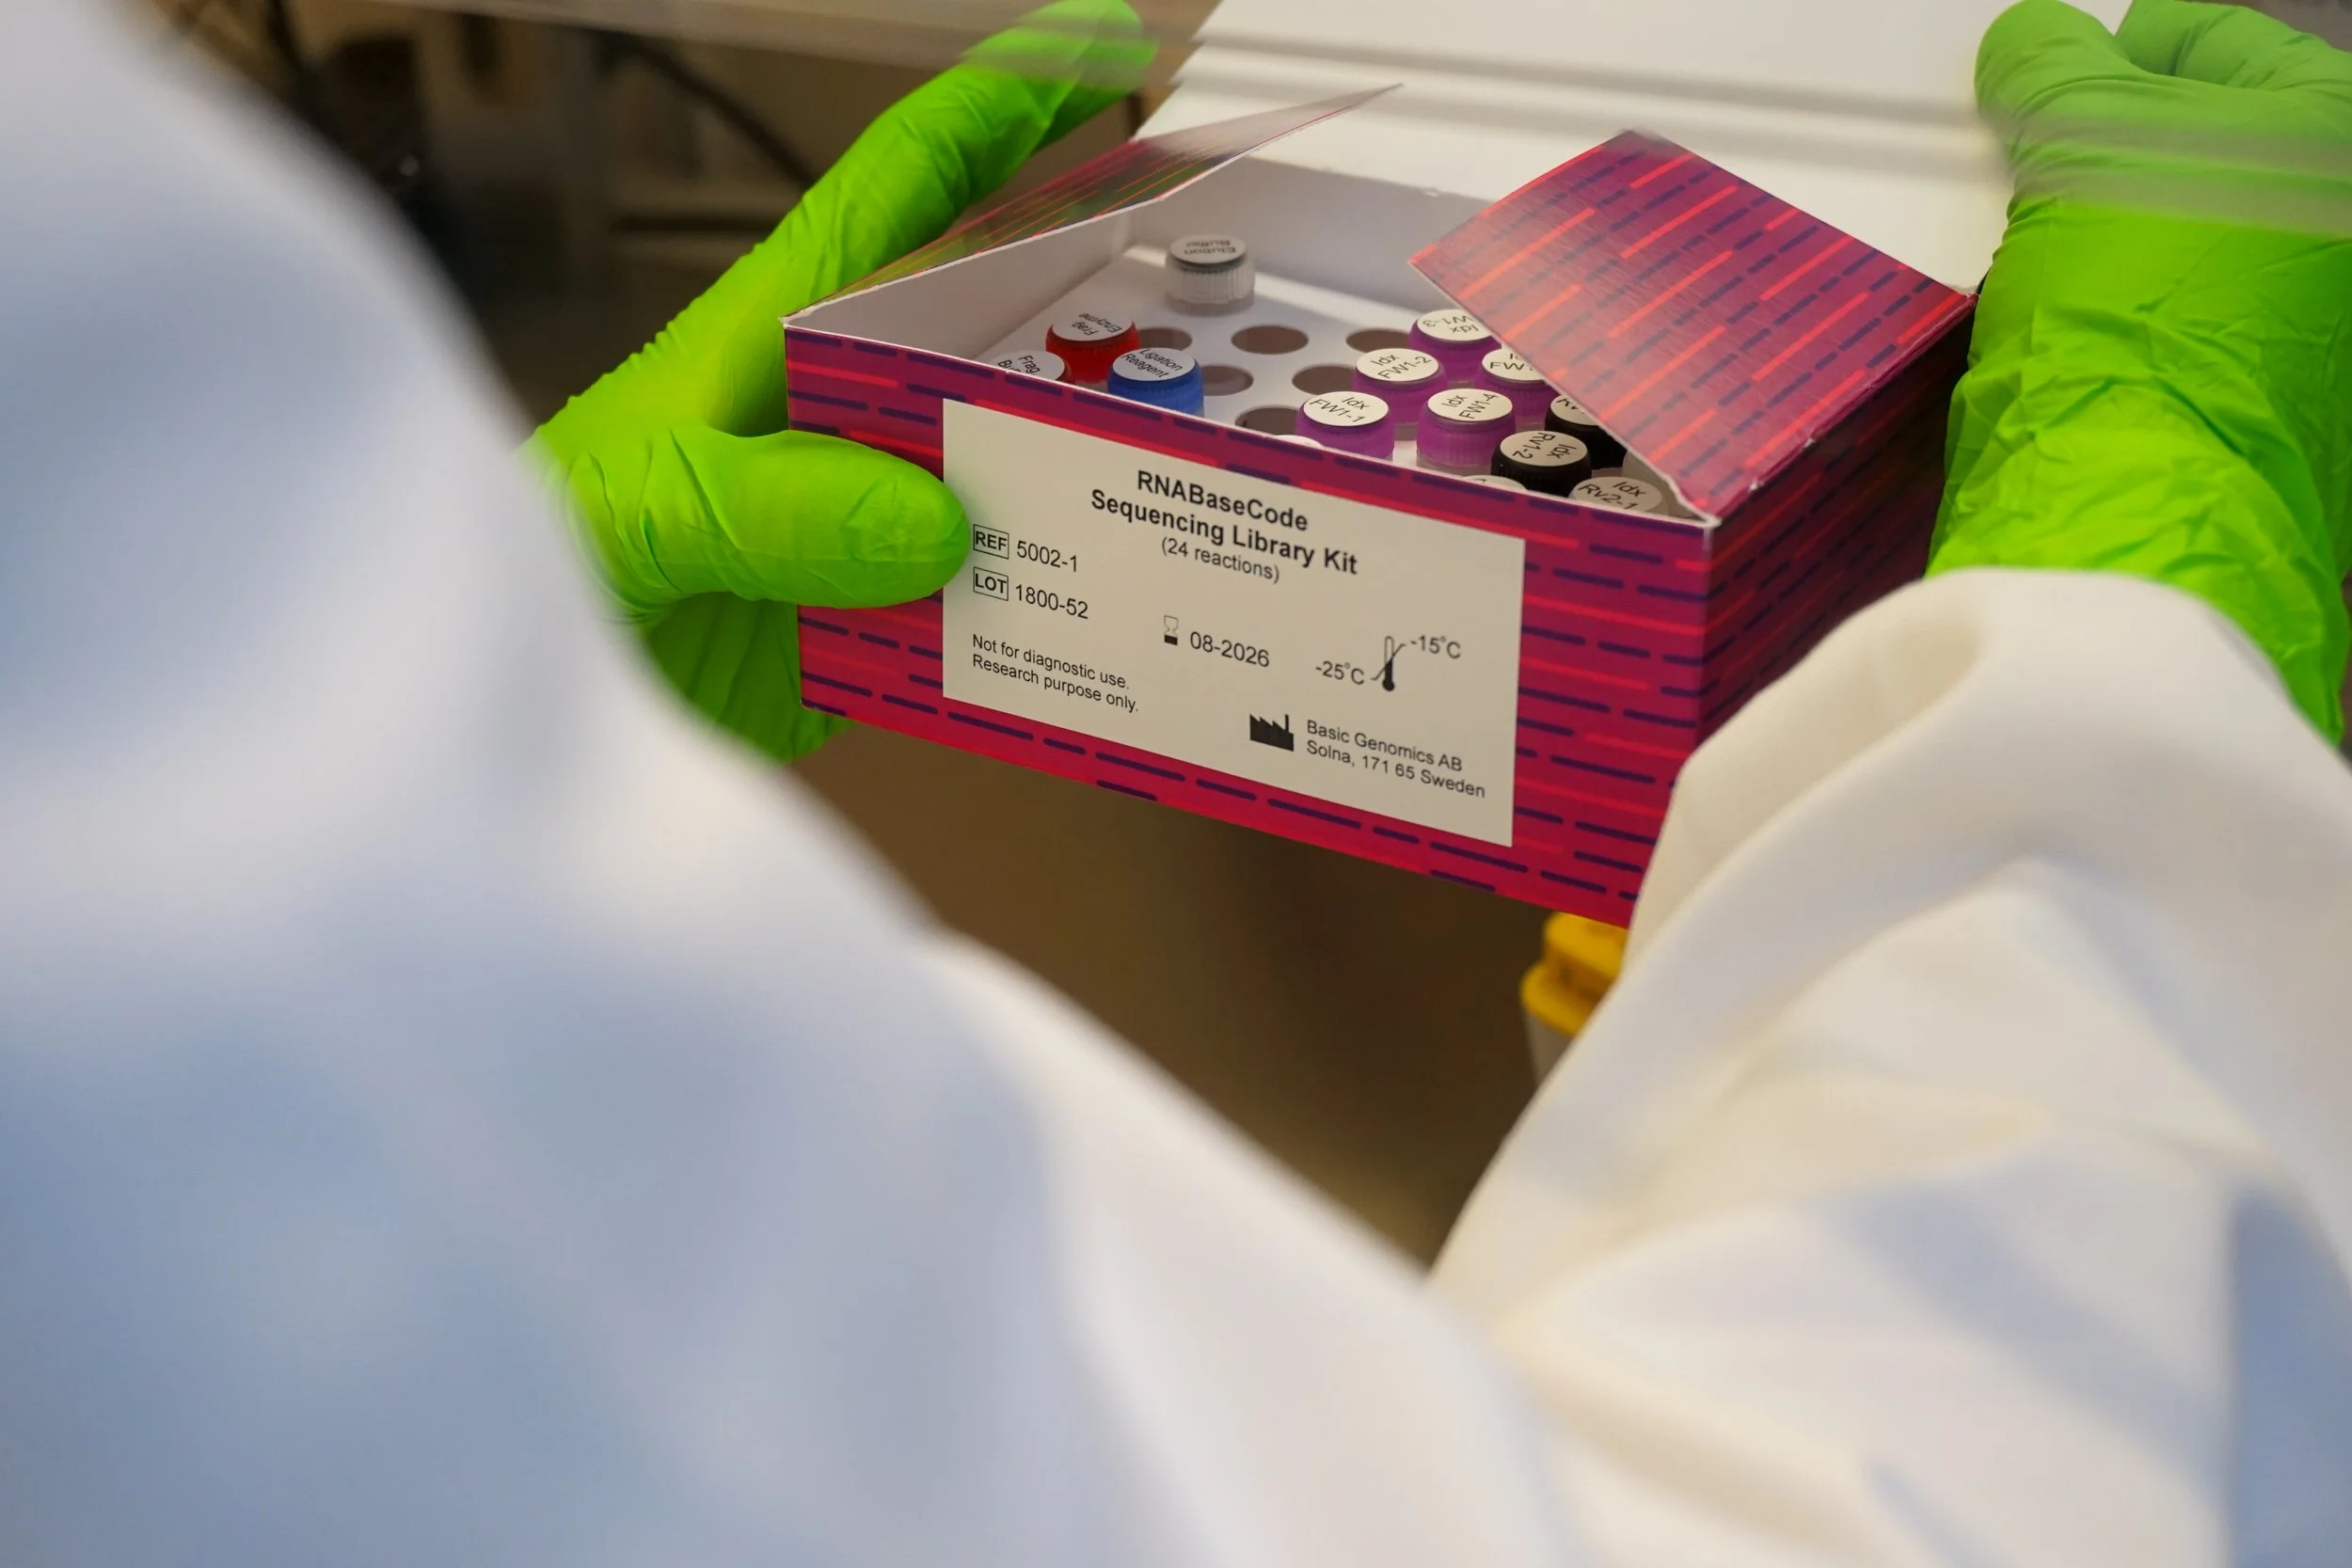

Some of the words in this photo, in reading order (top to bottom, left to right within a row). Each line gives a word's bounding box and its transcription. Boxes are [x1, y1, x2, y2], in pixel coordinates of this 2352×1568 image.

[1078, 313, 1122, 333] Enzyme
[1422, 315, 1475, 327] W1-3
[1449, 324, 1479, 333] Idx
[1121, 353, 1169, 378] Reagent
[1139, 348, 1183, 371] Ligation
[1371, 354, 1401, 366] Idx
[1377, 356, 1432, 379] FW1-2
[1310, 398, 1366, 423] FW1-1
[1342, 396, 1371, 410] Idx
[1441, 394, 1469, 407] Idx
[1458, 393, 1499, 420] FW1-4
[1547, 444, 1577, 459] Idx
[1137, 470, 1309, 531] RNABaseCode
[1578, 483, 1640, 510] Rv2-1
[1612, 481, 1645, 498] Idx
[1091, 488, 1224, 546] Sequencing
[1232, 525, 1315, 568] Library
[1324, 547, 1358, 575] Kit
[975, 531, 1008, 551] REF
[1016, 540, 1077, 572] 5002-1
[1161, 536, 1188, 557] (24
[1194, 547, 1279, 584] reactions)
[975, 573, 1007, 594] LOT
[1015, 584, 1089, 620] 1800-52
[1189, 631, 1270, 668] 08-2026
[1409, 634, 1462, 659] -15°C
[972, 633, 997, 654] Not
[1000, 641, 1020, 658] for
[1023, 649, 1096, 680] diagnostic
[1100, 671, 1130, 689] use.
[1314, 660, 1366, 686] -25°C
[972, 653, 1040, 685] Research
[1043, 675, 1102, 702] purpose
[1105, 693, 1139, 713] only.
[1307, 720, 1350, 743] Basic
[1354, 732, 1435, 766] Genomics
[1438, 753, 1463, 772] AB
[1307, 739, 1356, 768] Solna,
[1362, 755, 1389, 774] 171
[1394, 764, 1416, 780] 65
[1421, 769, 1486, 799] Sweden
